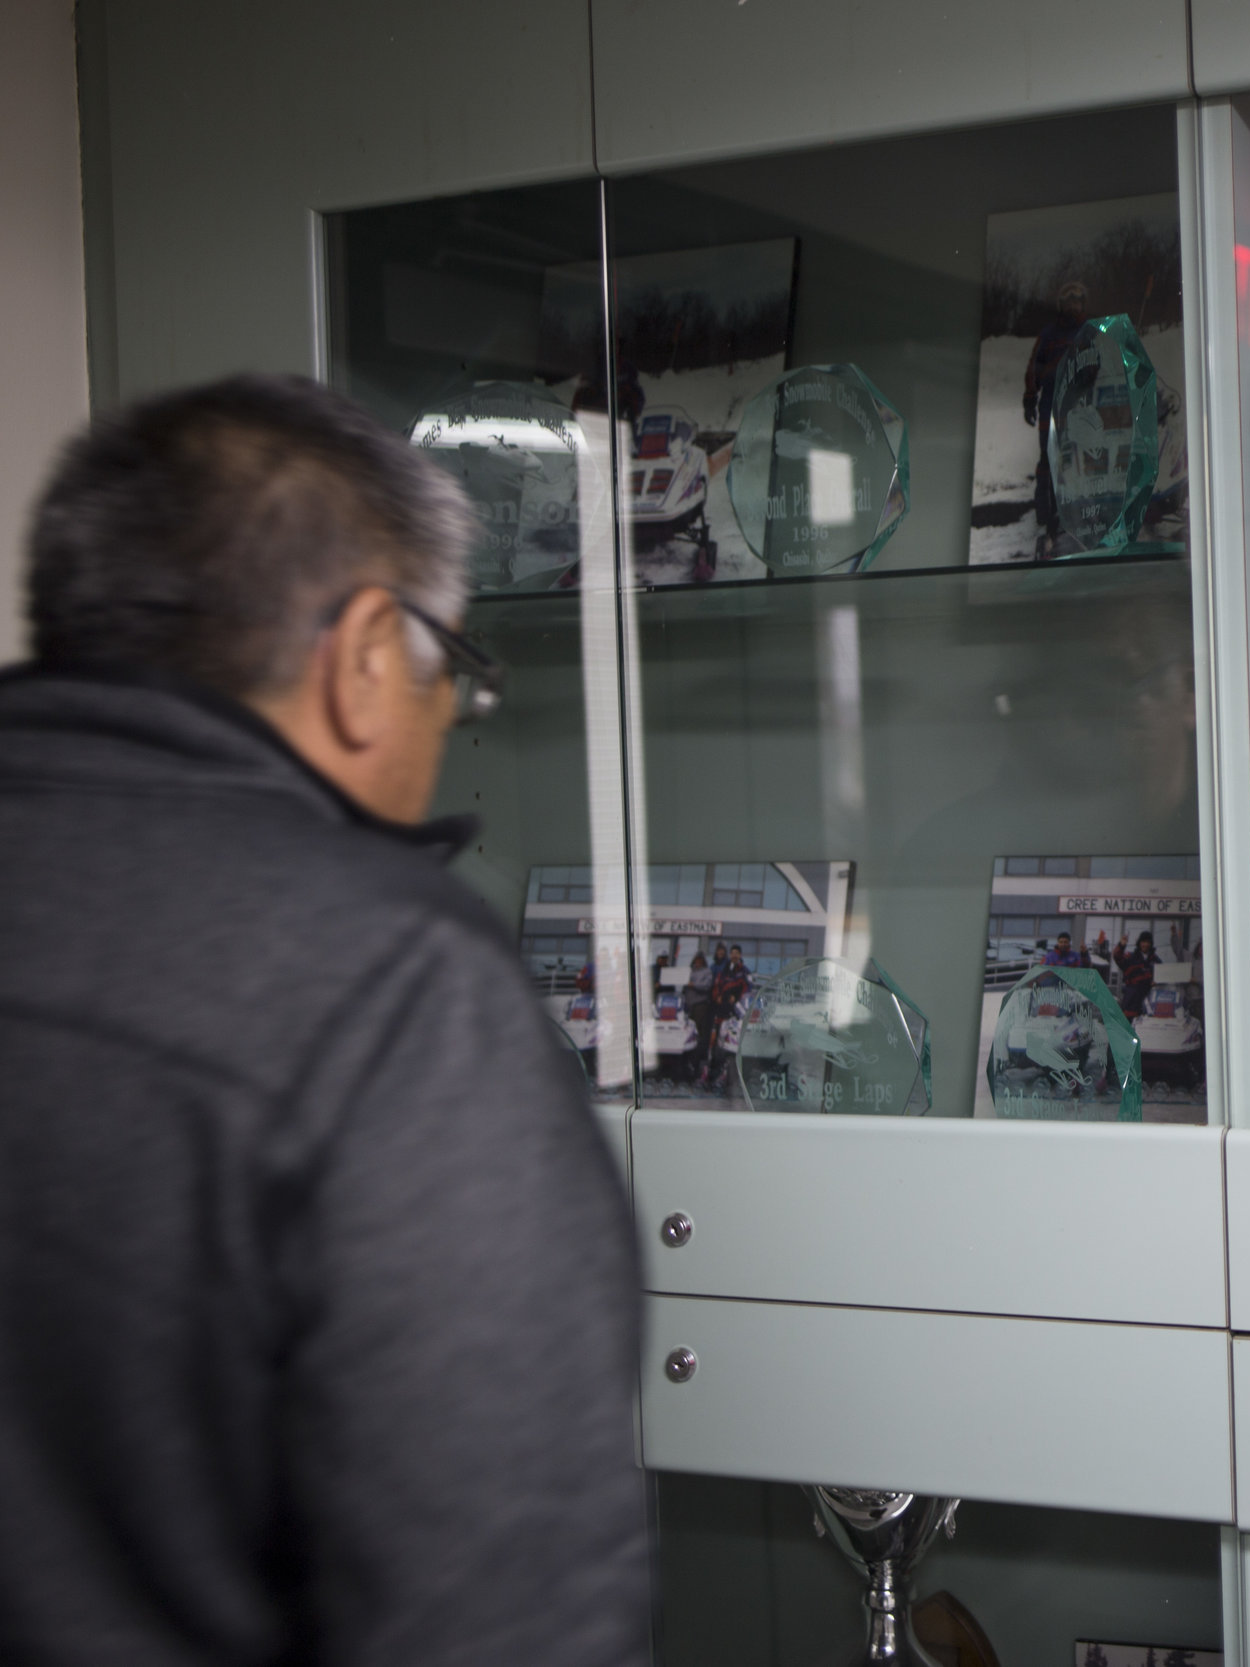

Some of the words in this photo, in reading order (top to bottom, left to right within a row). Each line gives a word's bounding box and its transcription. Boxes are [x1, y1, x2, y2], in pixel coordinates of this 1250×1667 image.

[793, 526, 829, 542] 1996
[1067, 898, 1098, 911] CREE
[1105, 899, 1151, 911] NATION
[1158, 900, 1172, 912] OF
[670, 922, 717, 933] EASTMAIN
[760, 1072, 787, 1100] 3rd
[854, 1076, 892, 1112] Laps
